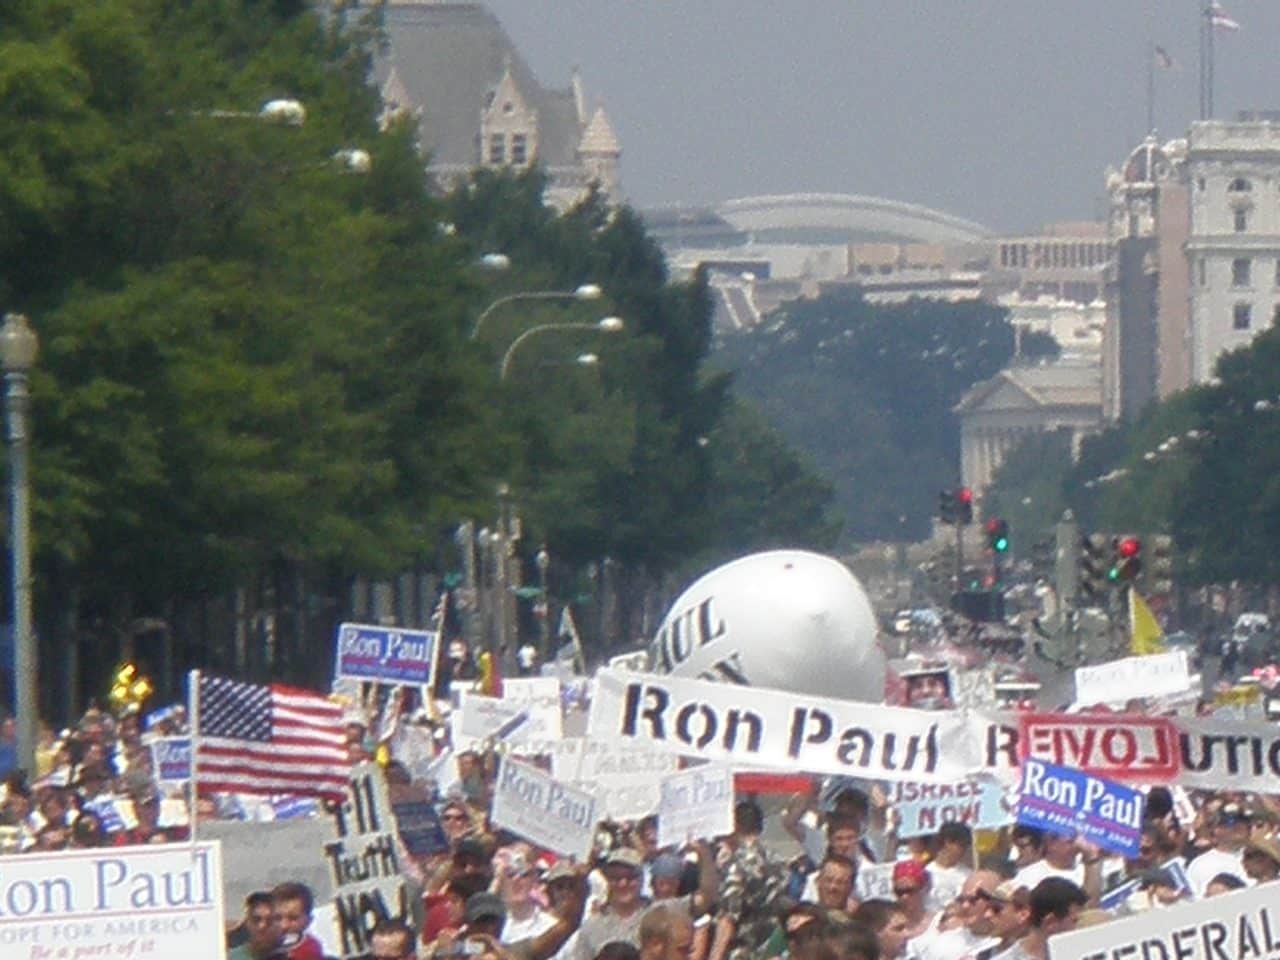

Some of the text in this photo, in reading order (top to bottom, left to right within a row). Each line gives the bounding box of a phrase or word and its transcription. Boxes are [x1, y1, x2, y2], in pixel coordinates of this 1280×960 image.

[384, 631, 433, 662] Paul
[654, 596, 726, 675] AUL
[621, 683, 938, 773] Ron Paul
[545, 780, 596, 828] Paul
[917, 801, 982, 830] NOW
[1023, 760, 1143, 829] Ron Paul
[0, 852, 215, 916] on Paul
[0, 917, 199, 944] OPE FOR AMERICA
